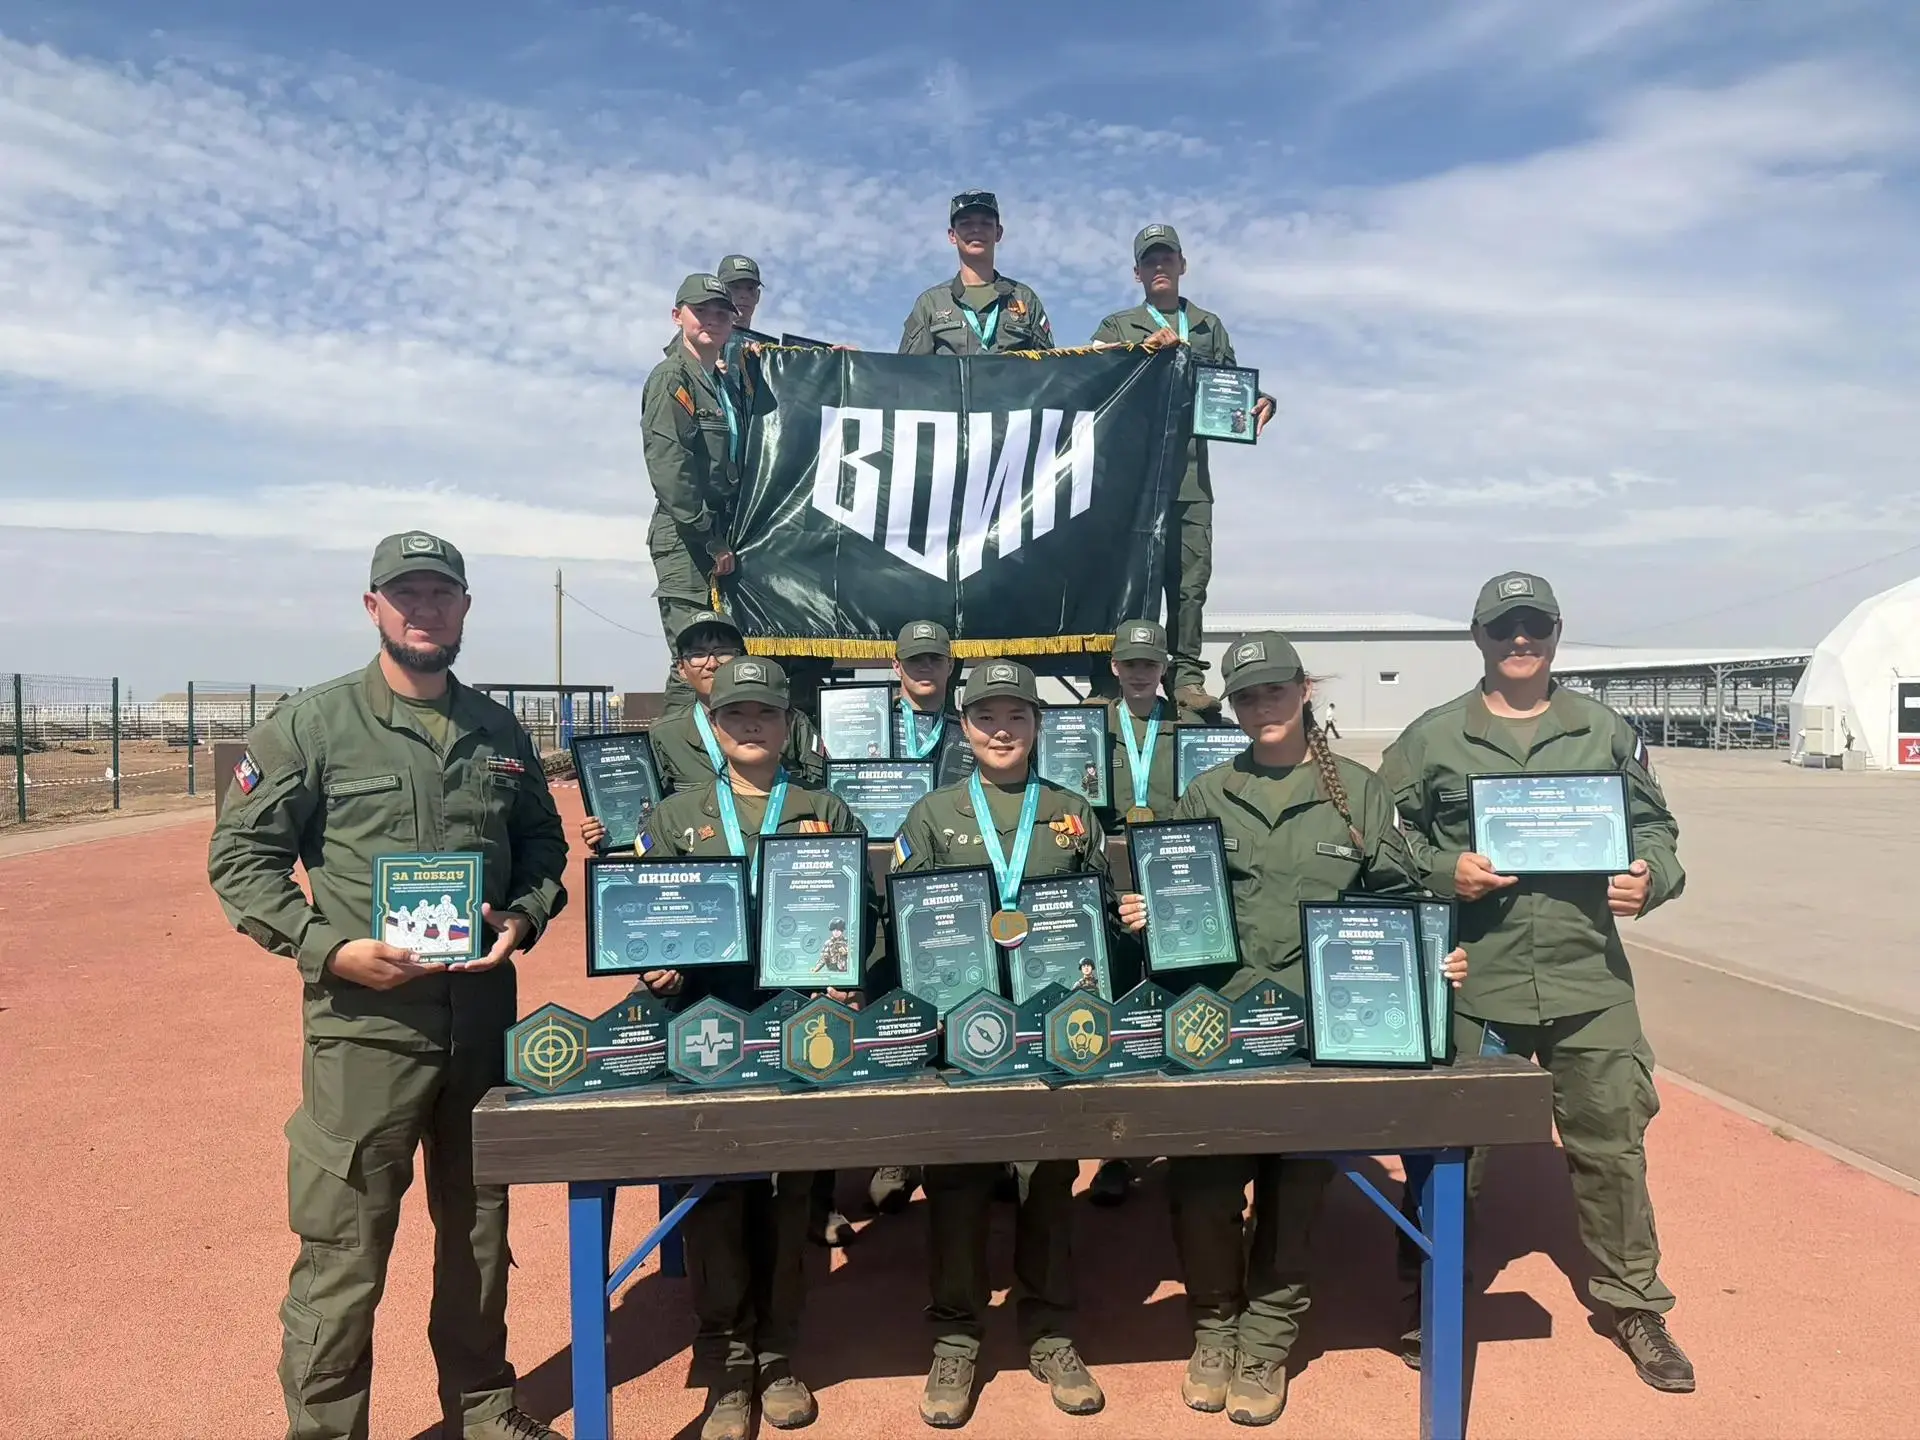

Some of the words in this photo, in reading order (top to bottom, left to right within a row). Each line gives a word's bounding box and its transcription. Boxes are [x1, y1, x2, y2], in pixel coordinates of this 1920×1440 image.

[811, 405, 1096, 582] ВОИН
[857, 770, 903, 779] ДИПЛОМ
[791, 861, 834, 870] ДИПЛОМ
[392, 871, 409, 881] ЗА
[413, 870, 465, 881] ПОБЕДУ
[638, 872, 701, 884] ДИПЛОМ
[922, 894, 964, 906] ДИПЛОМ
[1032, 901, 1074, 912] ДИПЛОМ
[1338, 930, 1385, 939] ДИПЛОМ
